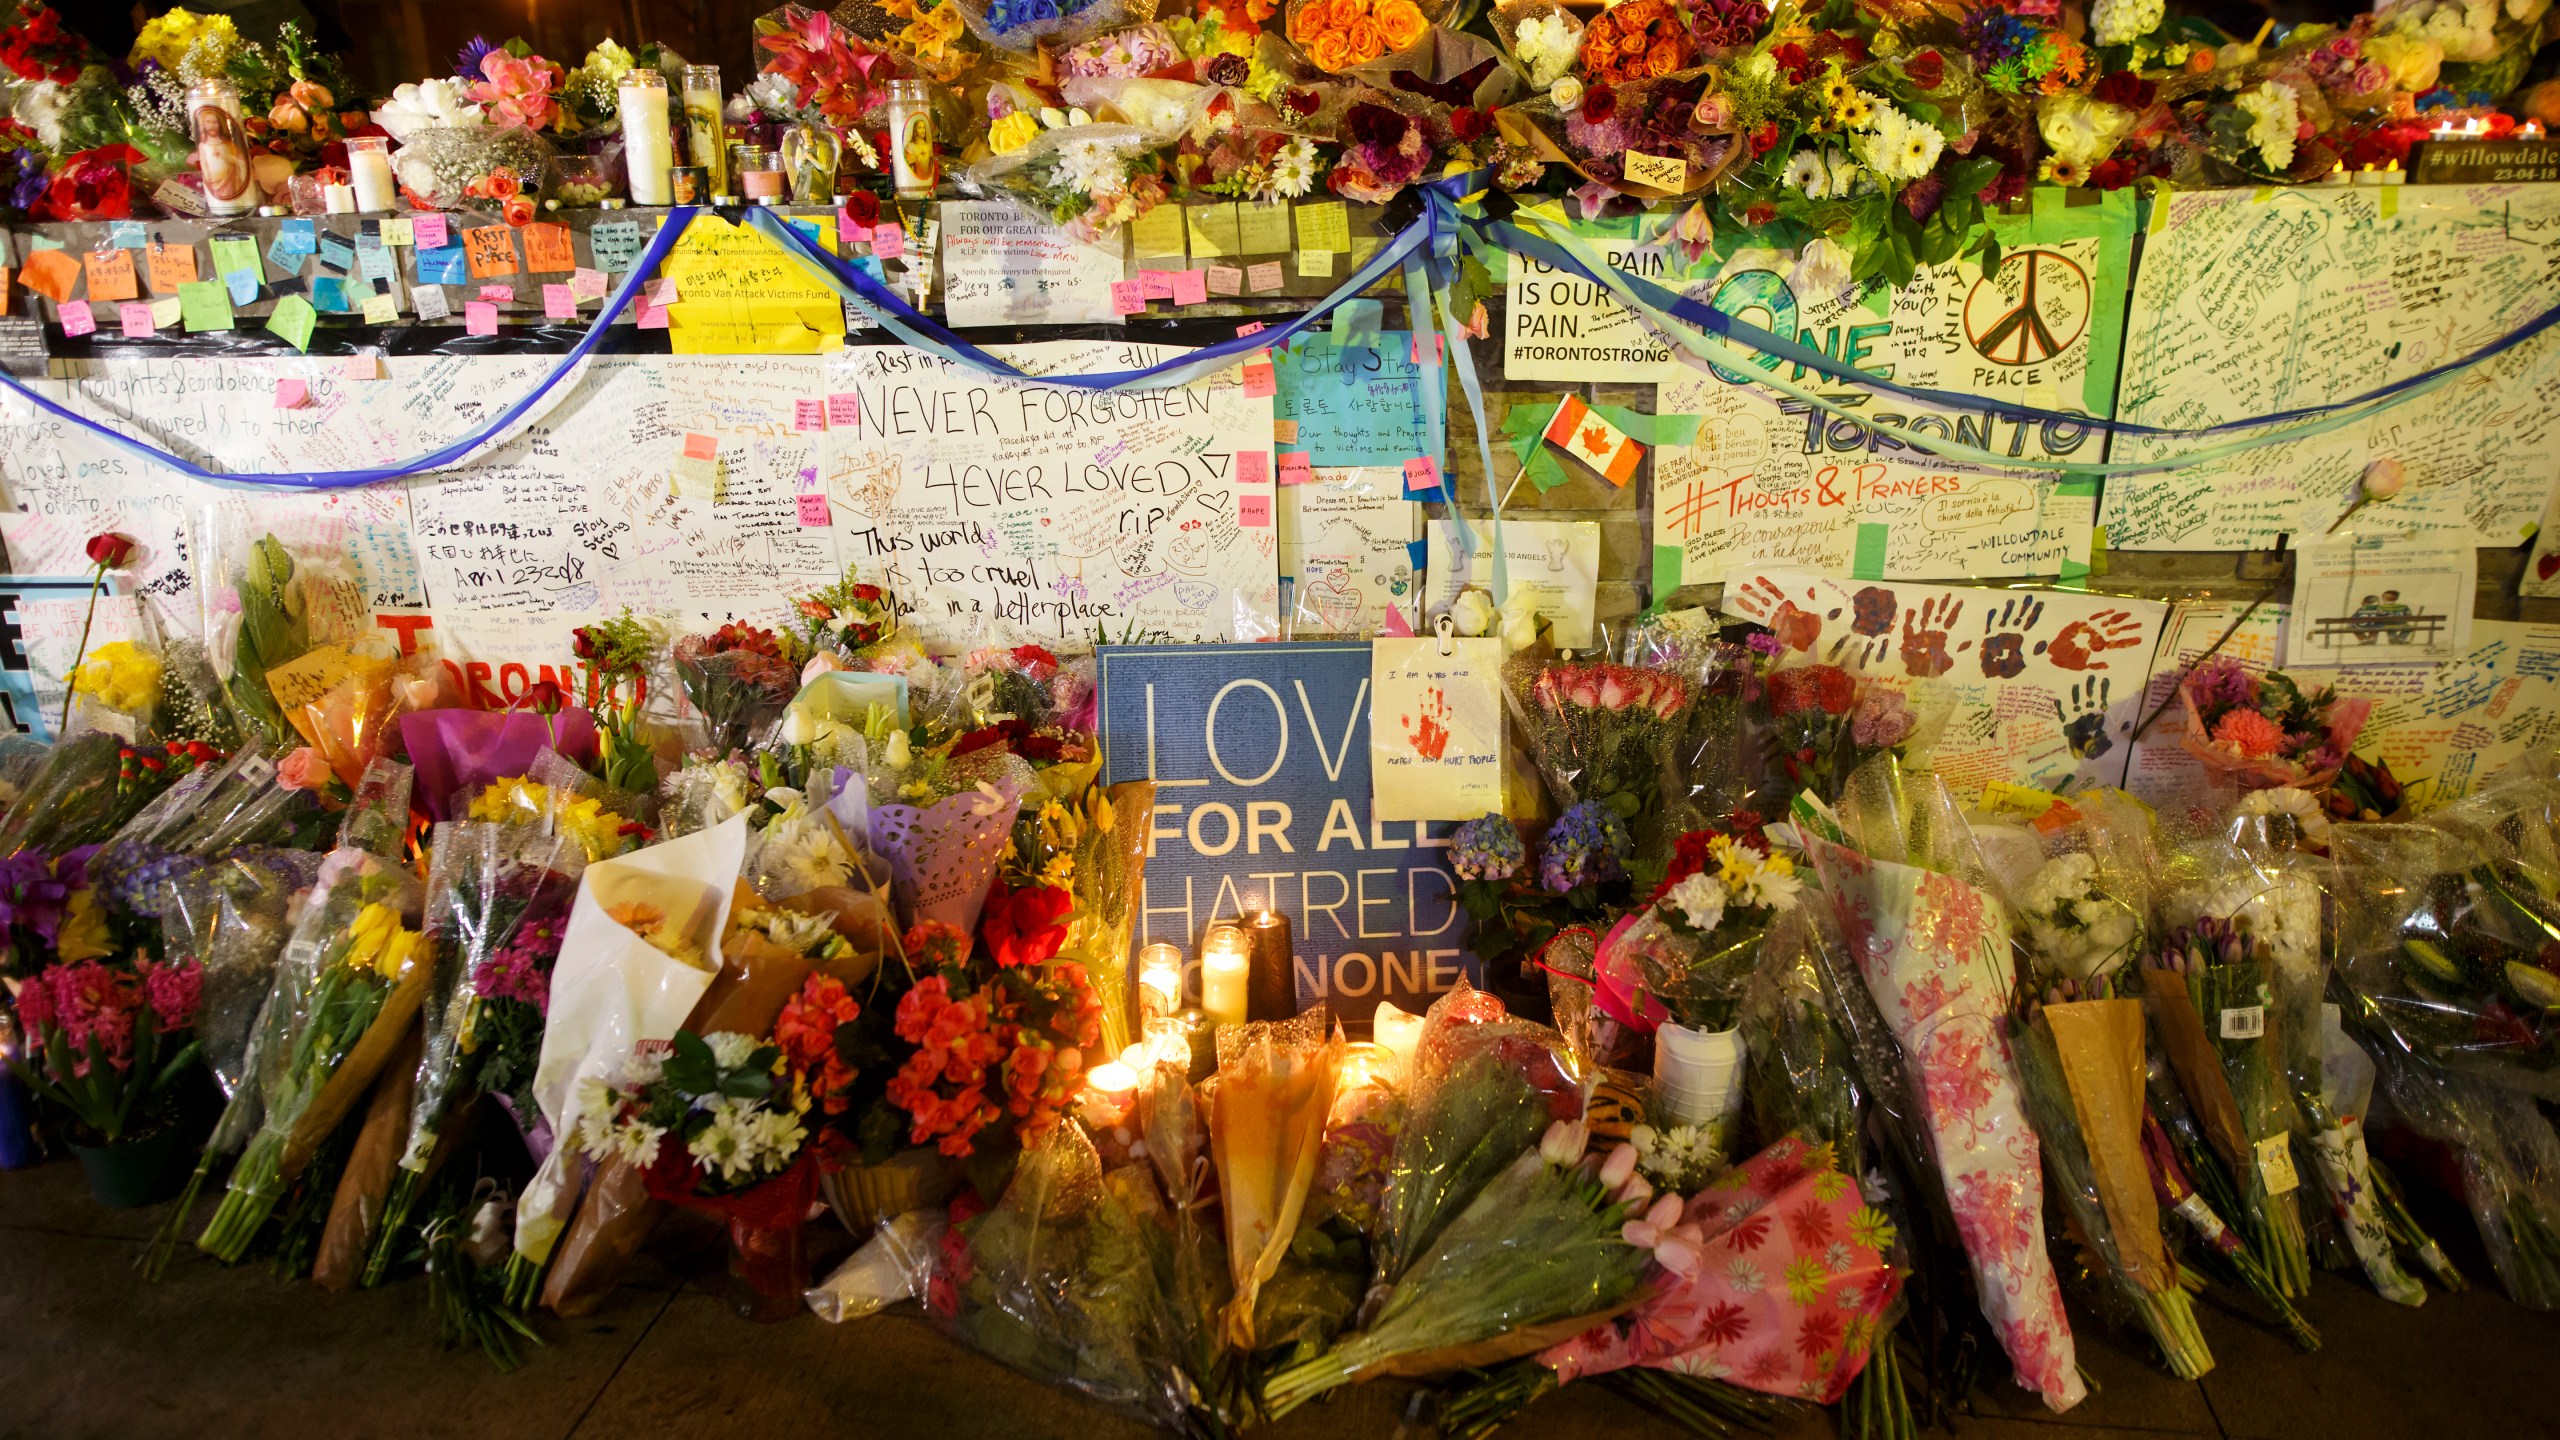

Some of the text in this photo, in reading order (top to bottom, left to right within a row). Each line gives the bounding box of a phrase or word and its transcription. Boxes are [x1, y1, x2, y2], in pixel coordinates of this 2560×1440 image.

[1648, 160, 1664, 168] our
[2494, 169, 2557, 180] 23-04-18
[960, 212, 1008, 221] TORONTO
[960, 226, 1038, 235] FOR OUR GREAT
[484, 243, 500, 251] IN
[962, 269, 987, 277] Speedy
[989, 269, 1021, 277] Recovery
[1045, 269, 1071, 277] Injured
[678, 290, 830, 299] oronto Van Attack Victims Fund
[1519, 282, 1610, 306] IS OUR
[1942, 269, 1966, 354] UNITY
[1517, 315, 1585, 338] PAIN.
[1702, 269, 1896, 386] ONE
[2261, 312, 2292, 332] sorry
[918, 352, 933, 368] in
[1514, 346, 1669, 362] #TORONTOSTRONG
[667, 361, 687, 369] our
[691, 360, 739, 376] thoughts
[1300, 347, 1421, 386] Stay Stro
[188, 372, 278, 395] condolence
[1973, 368, 2042, 387] PEACE
[856, 381, 1212, 441] NEVER FORGOTTEN
[1348, 399, 1421, 413] 사랑합니다
[273, 412, 325, 435] their
[1776, 393, 2091, 457] TORONTO
[1298, 426, 1320, 438] Our
[1333, 426, 1370, 443] thoughts
[1396, 426, 1426, 441] Prayers
[1314, 443, 1325, 451] to
[1336, 445, 1372, 453] victims
[1822, 452, 1870, 466] United
[1311, 472, 1348, 481] anada
[1816, 465, 1847, 507] &
[1852, 463, 1960, 502] PRAYERS
[925, 460, 1191, 516] 4EVER LOVED
[1992, 492, 2000, 501] la
[851, 526, 914, 556] This
[1685, 536, 1702, 548] GOD
[2001, 545, 2071, 565] COMMUNITY
[454, 567, 504, 588] April
[883, 560, 911, 585] is
[918, 557, 965, 585] too
[19, 603, 47, 617] MAY
[50, 604, 80, 619] THE
[947, 596, 963, 617] in
[972, 599, 983, 612] a
[23, 621, 126, 639] BE WIT YOU
[1389, 671, 1396, 679] I
[1146, 677, 1369, 787] LOV
[1444, 756, 1465, 765] HURT
[1146, 798, 1451, 858] FOR ALL
[1141, 867, 1458, 947] HATRED
[1294, 948, 1461, 998] NONE
